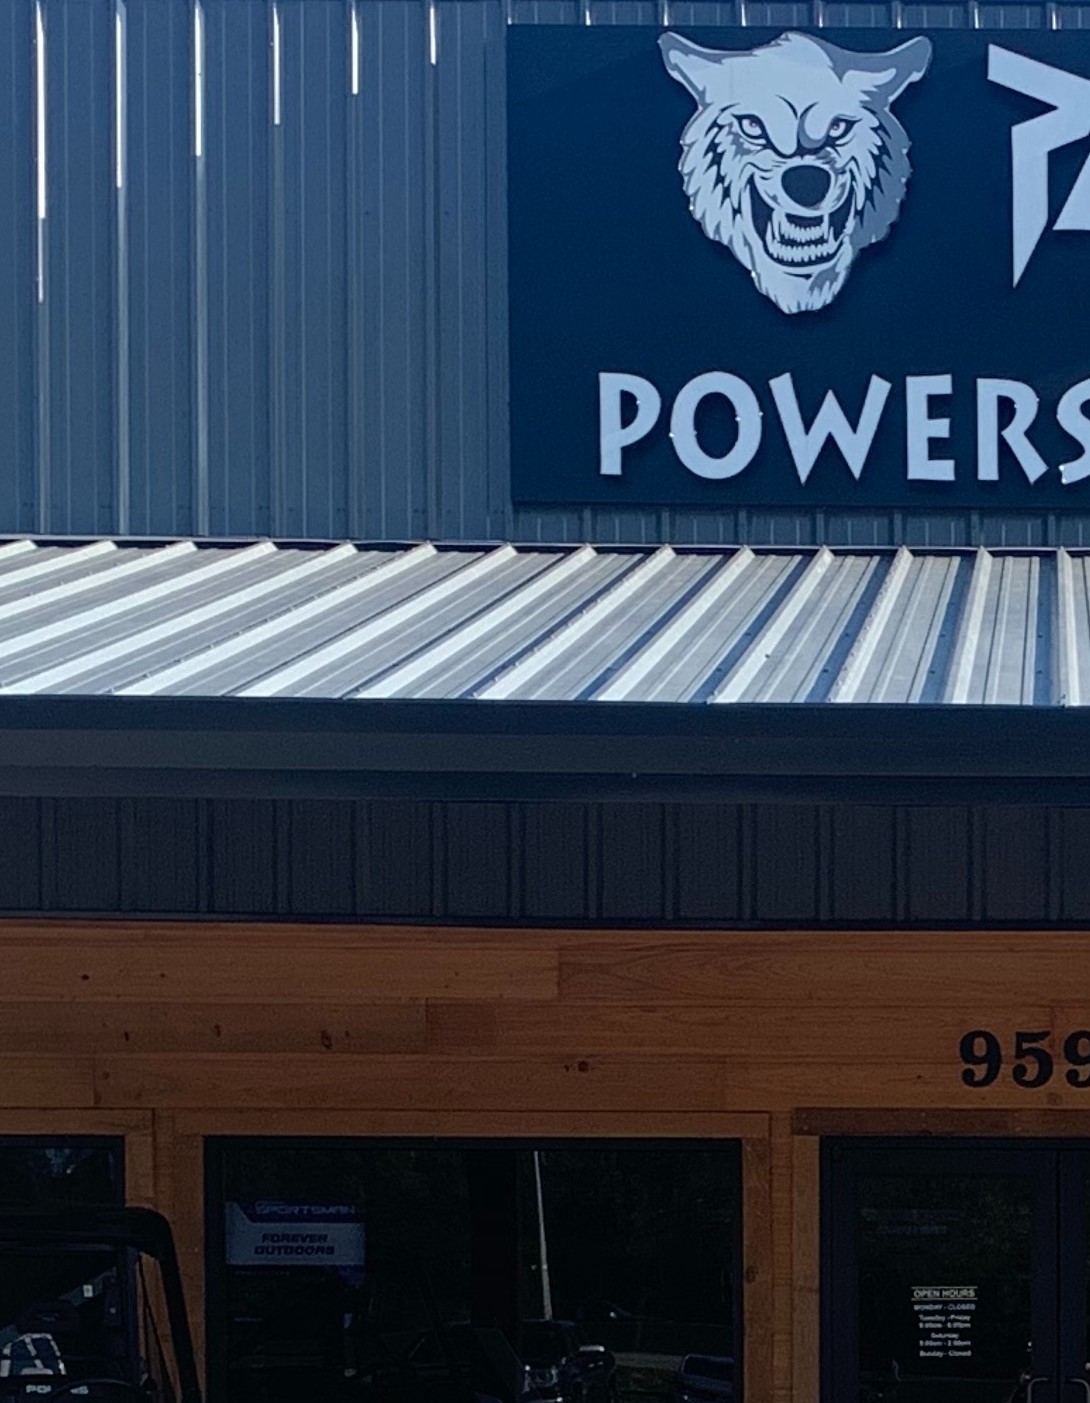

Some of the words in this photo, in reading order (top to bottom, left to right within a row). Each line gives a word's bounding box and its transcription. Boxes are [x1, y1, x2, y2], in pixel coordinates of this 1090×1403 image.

[254, 1201, 356, 1215] SPORTSMAN
[261, 1233, 329, 1244] FOREVER
[254, 1245, 335, 1256] OUTDOORS
[913, 1289, 940, 1298] OPEN
[942, 1289, 976, 1298] HOURS
